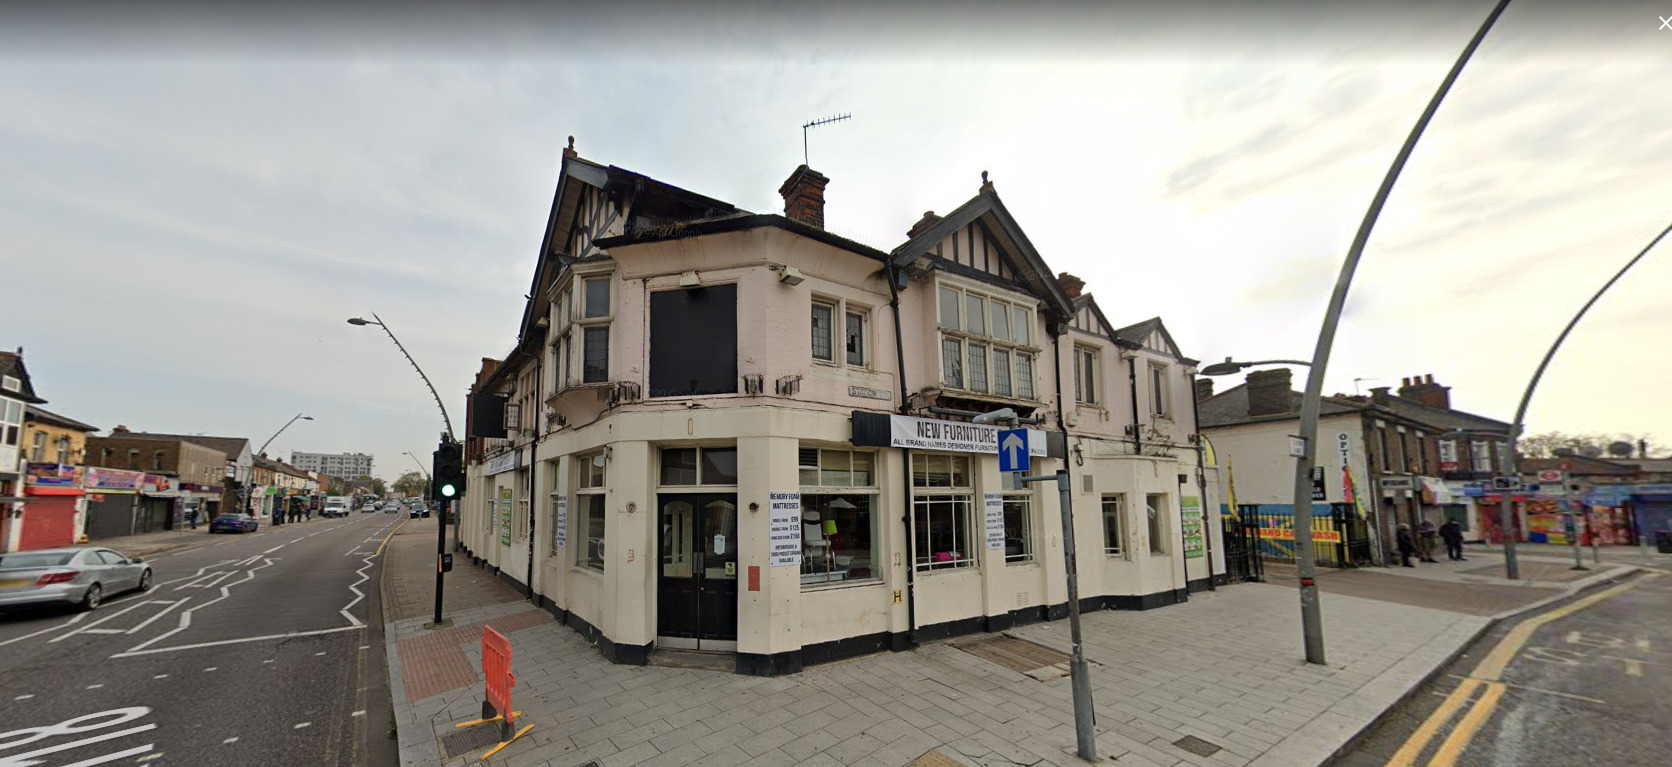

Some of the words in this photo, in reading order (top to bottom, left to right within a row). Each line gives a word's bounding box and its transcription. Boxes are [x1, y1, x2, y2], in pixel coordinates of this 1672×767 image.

[851, 386, 877, 397] STATION
[916, 421, 941, 440] NEW
[943, 424, 996, 444] FURNITURE
[893, 438, 905, 446] ALL
[905, 439, 927, 448] BRAND
[947, 442, 974, 451] DESIGNER
[974, 445, 999, 453] FURNITUR
[770, 493, 788, 501] MEMORY
[772, 502, 799, 510] MATTRESSES
[893, 590, 902, 603] H
